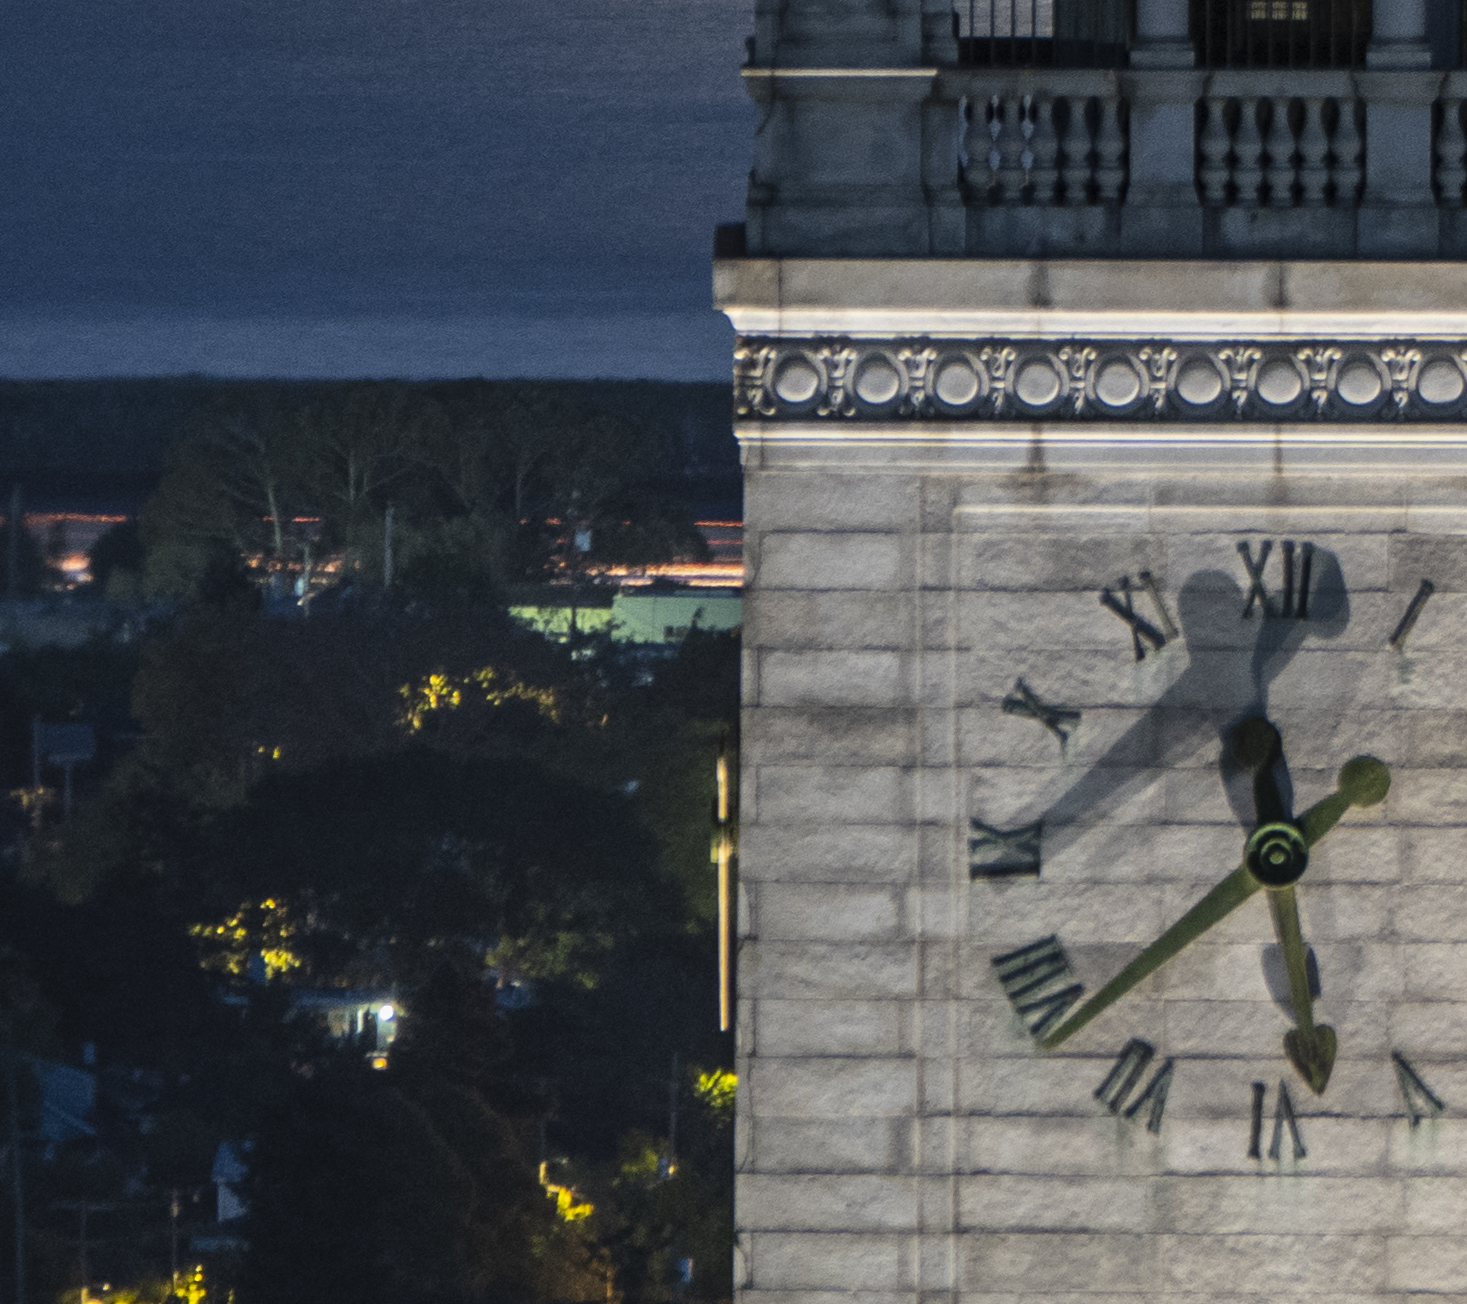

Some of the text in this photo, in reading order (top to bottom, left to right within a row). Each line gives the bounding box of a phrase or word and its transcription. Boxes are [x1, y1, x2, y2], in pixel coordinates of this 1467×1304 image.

[1100, 571, 1179, 661] XI
[1236, 539, 1314, 620] XII
[1002, 677, 1081, 743] X
[969, 816, 1042, 881] IX
[1094, 1037, 1175, 1136] VII
[1247, 1078, 1307, 1160] VI
[1391, 1049, 1446, 1130] V
